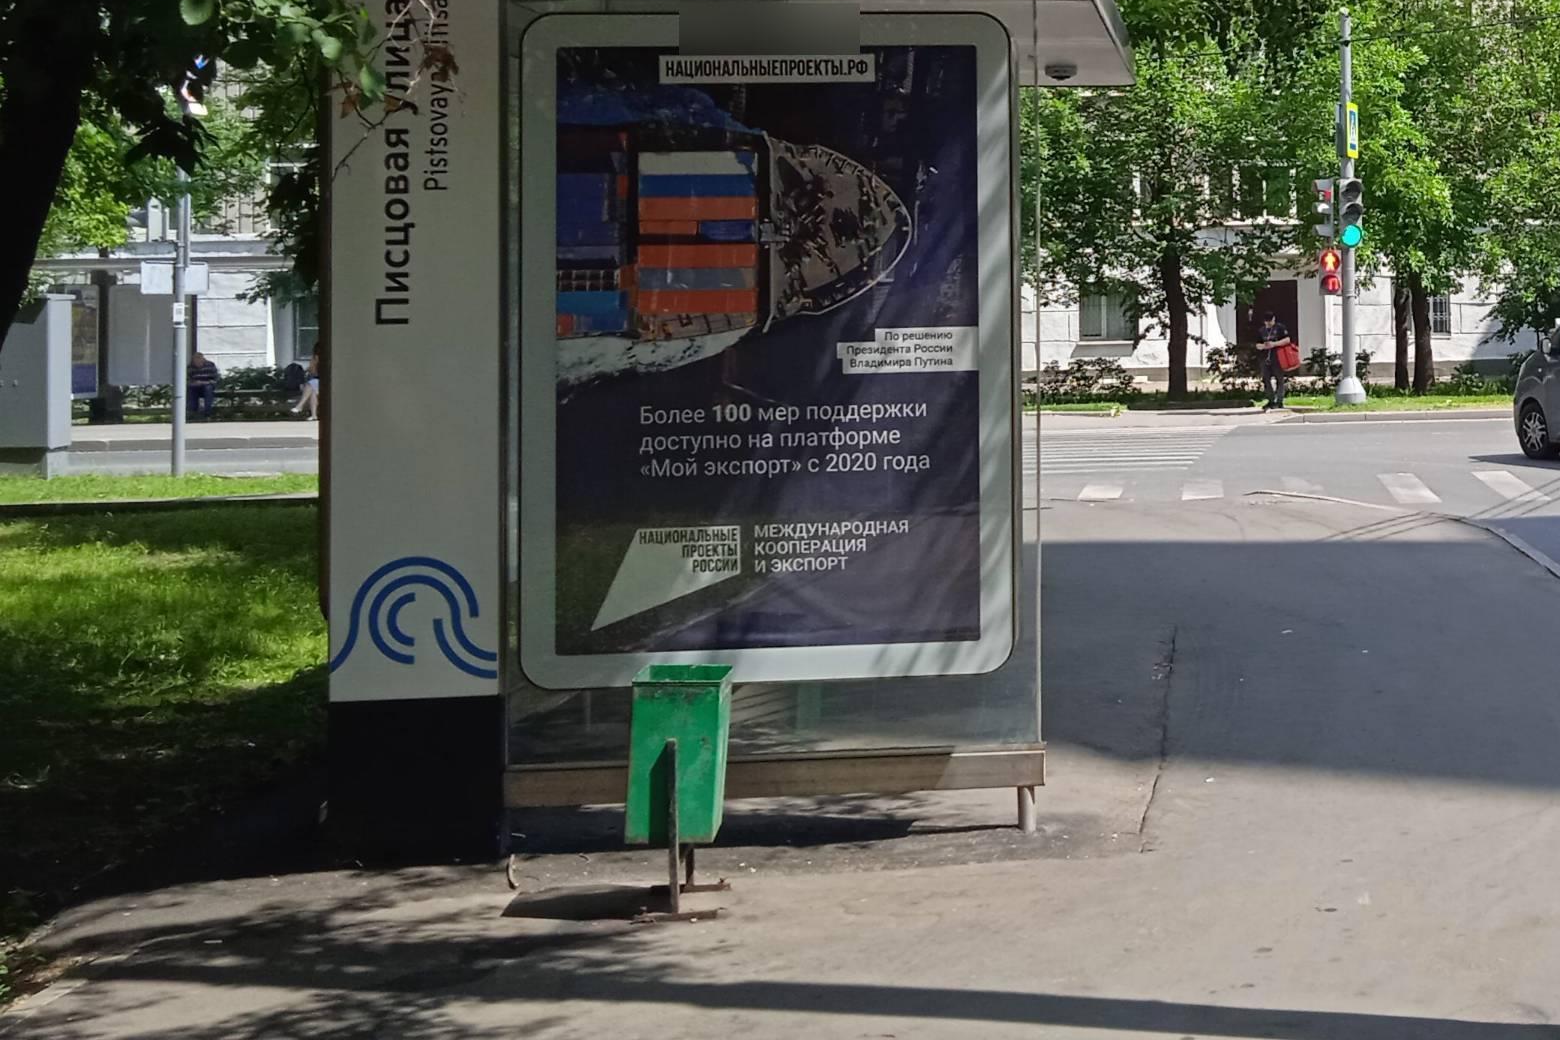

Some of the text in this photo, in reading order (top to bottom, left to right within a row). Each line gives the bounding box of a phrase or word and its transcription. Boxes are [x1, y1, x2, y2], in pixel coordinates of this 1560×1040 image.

[665, 59, 869, 79] НАЦИОНАЛЬНЫЕПРОЕКТЫ.РФ
[375, 127, 415, 325] Писцовая
[884, 331, 953, 343] По решению
[846, 343, 953, 357] Президента России
[850, 356, 953, 369] Владимира Путина
[639, 403, 928, 425] Более 100 мер поддержки
[639, 427, 901, 455] доступно на платформе
[640, 452, 931, 478] «Мой экспорт» с 2020 года
[639, 528, 738, 545] НАЦИОНАЛЬНЫЕ
[753, 519, 910, 539] МЕЖДУНАРОДНАЯ
[682, 543, 738, 558] ПРОЕКТЫ
[753, 538, 867, 556] КООПЕРАЦИЯ
[692, 558, 738, 573] РОССИИ
[754, 556, 849, 573] И ЭКСПОРТ
